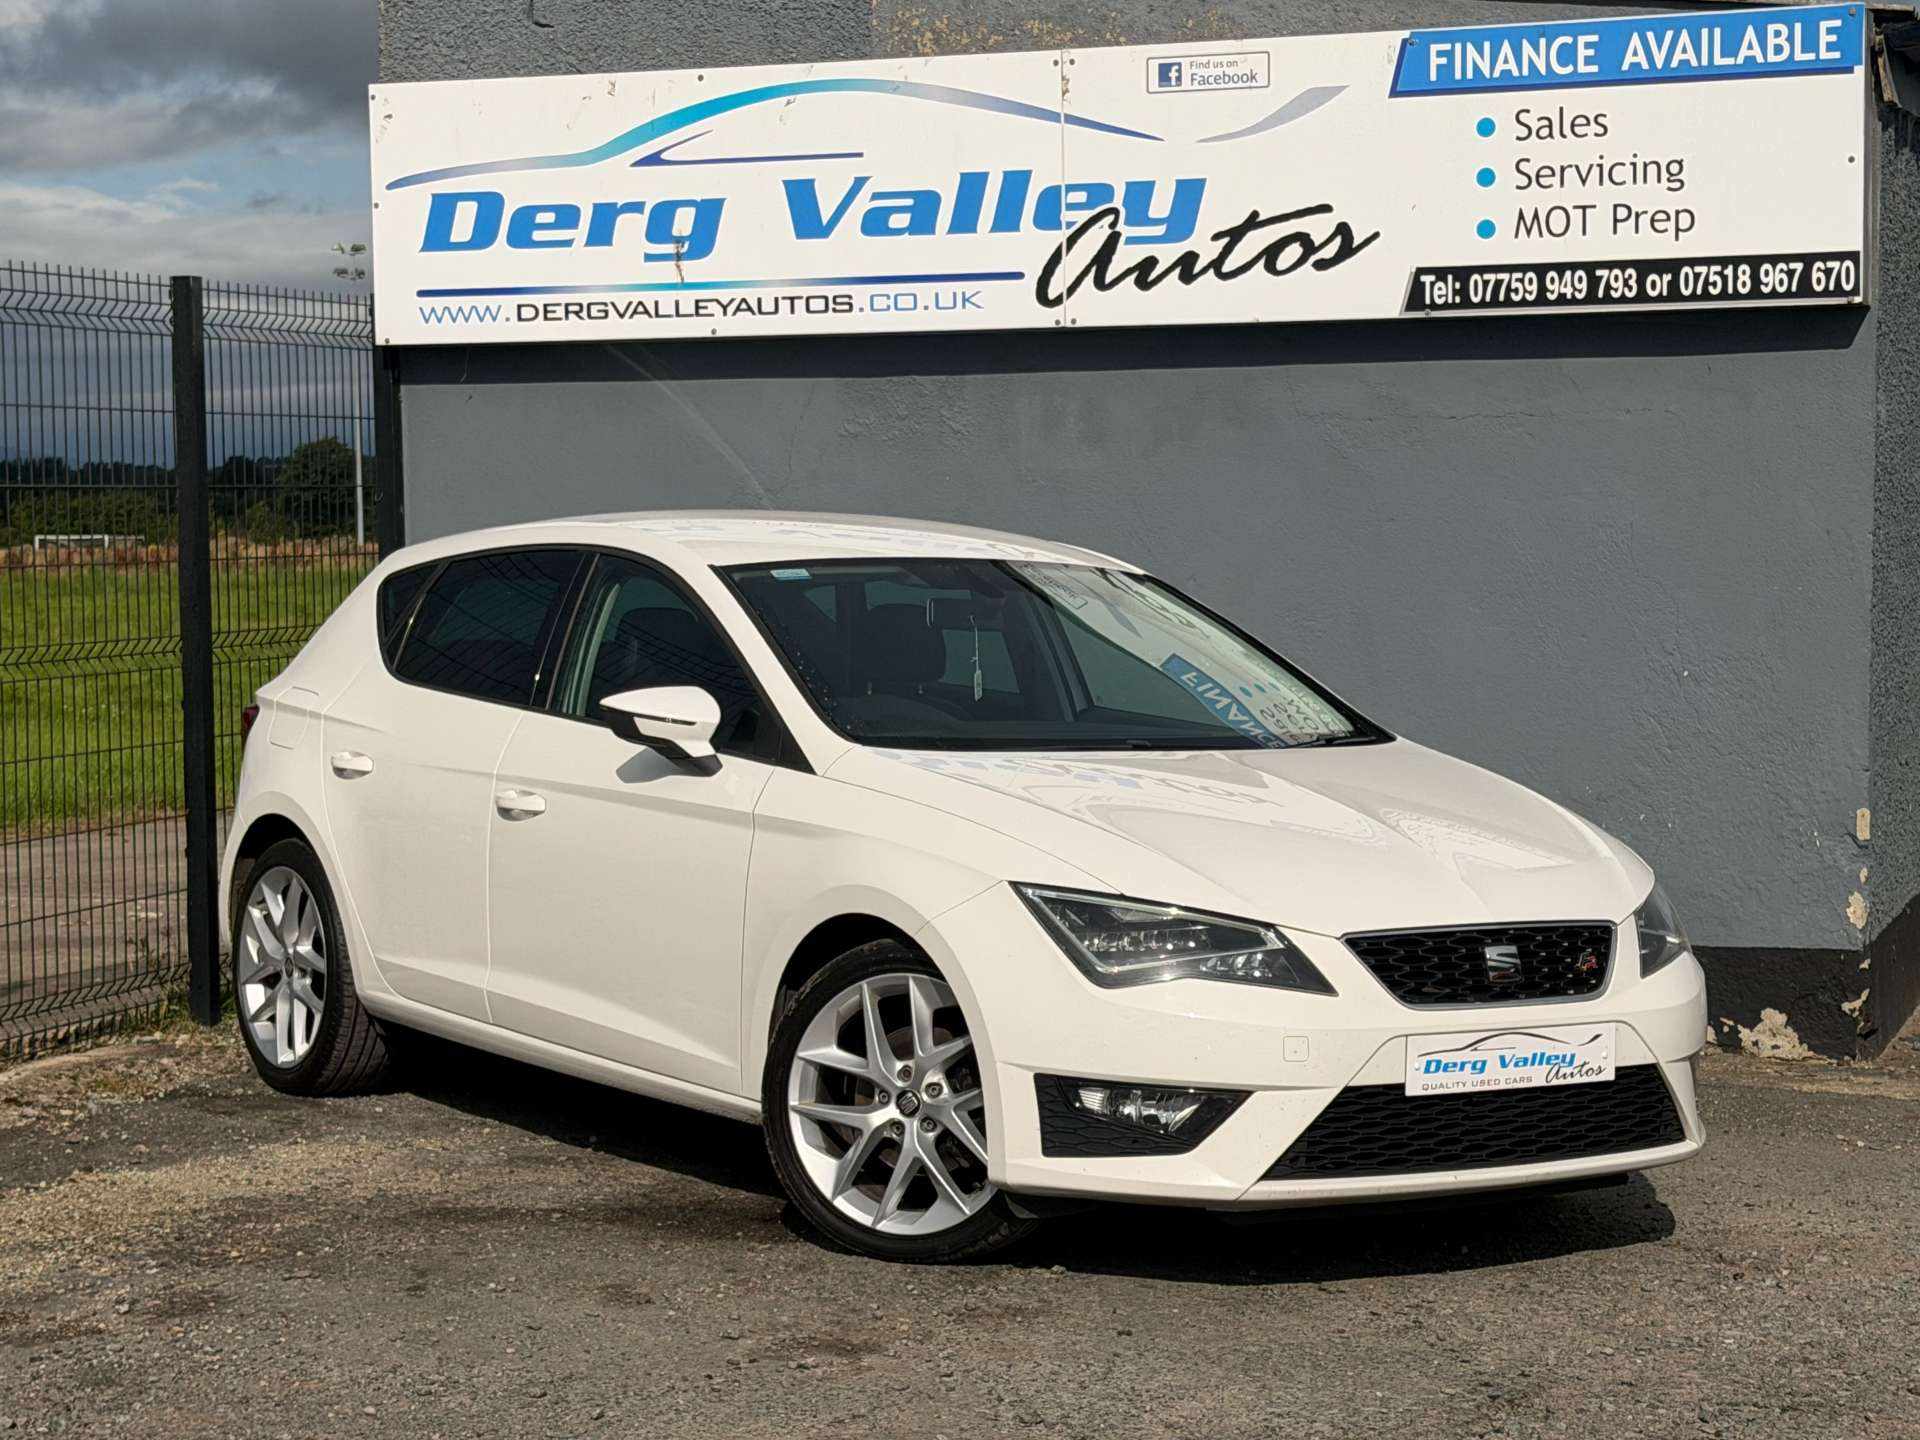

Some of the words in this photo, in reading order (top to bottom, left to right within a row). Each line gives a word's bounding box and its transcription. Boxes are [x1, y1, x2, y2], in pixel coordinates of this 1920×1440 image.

[1189, 60, 1211, 70] Find
[1212, 61, 1225, 69] us
[1226, 60, 1239, 69] on
[1429, 34, 1599, 82] FINANCE
[1621, 19, 1842, 71] AVAILABLE
[1190, 69, 1257, 86] Facebook
[1514, 106, 1609, 142] Sales
[1514, 153, 1685, 192] Servicing
[418, 191, 727, 263] Derg
[782, 169, 1208, 246] Valley
[1514, 204, 1597, 239] MOT
[1612, 203, 1696, 242] Prep
[1035, 203, 1381, 309] Autos
[1420, 274, 1461, 305] Tel:
[1469, 271, 1538, 304] 07759
[1545, 269, 1588, 301] 949
[1595, 267, 1638, 299] 793
[1645, 273, 1672, 297] or
[1679, 263, 1752, 296] 07518
[1759, 262, 1804, 294] 967
[1811, 259, 1855, 292] 670
[1423, 1058, 1488, 1075] Derg
[1498, 1051, 1577, 1069] Valley
[1545, 1060, 1606, 1084] Autos
[1422, 1080, 1467, 1092] QUALITY
[1471, 1078, 1501, 1088] USED
[1504, 1076, 1533, 1085] CARS
